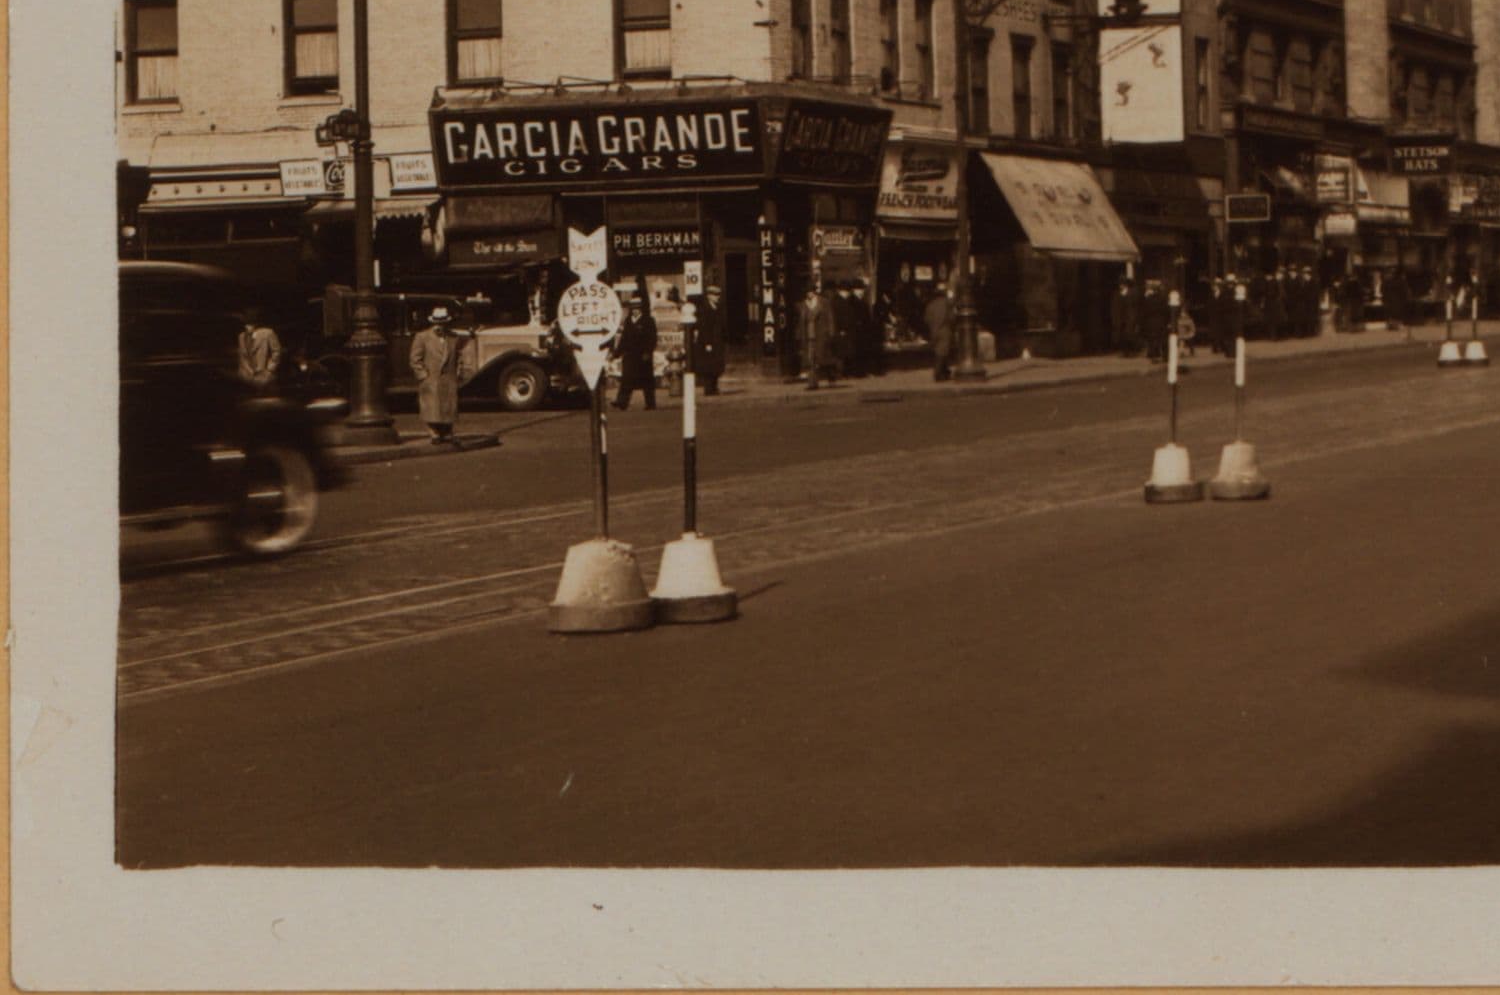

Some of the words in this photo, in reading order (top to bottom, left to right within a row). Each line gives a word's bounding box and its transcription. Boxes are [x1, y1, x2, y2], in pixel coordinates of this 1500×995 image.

[443, 120, 589, 164] GARCIA
[597, 108, 755, 154] GRANDE
[504, 154, 699, 176] CIGARS
[1404, 159, 1438, 171] HATS
[636, 232, 700, 248] BERKMAN
[568, 284, 608, 301] PASS
[760, 230, 775, 343] HELMAR
[563, 301, 600, 318] LEFT
[577, 310, 617, 325] RIGHT
